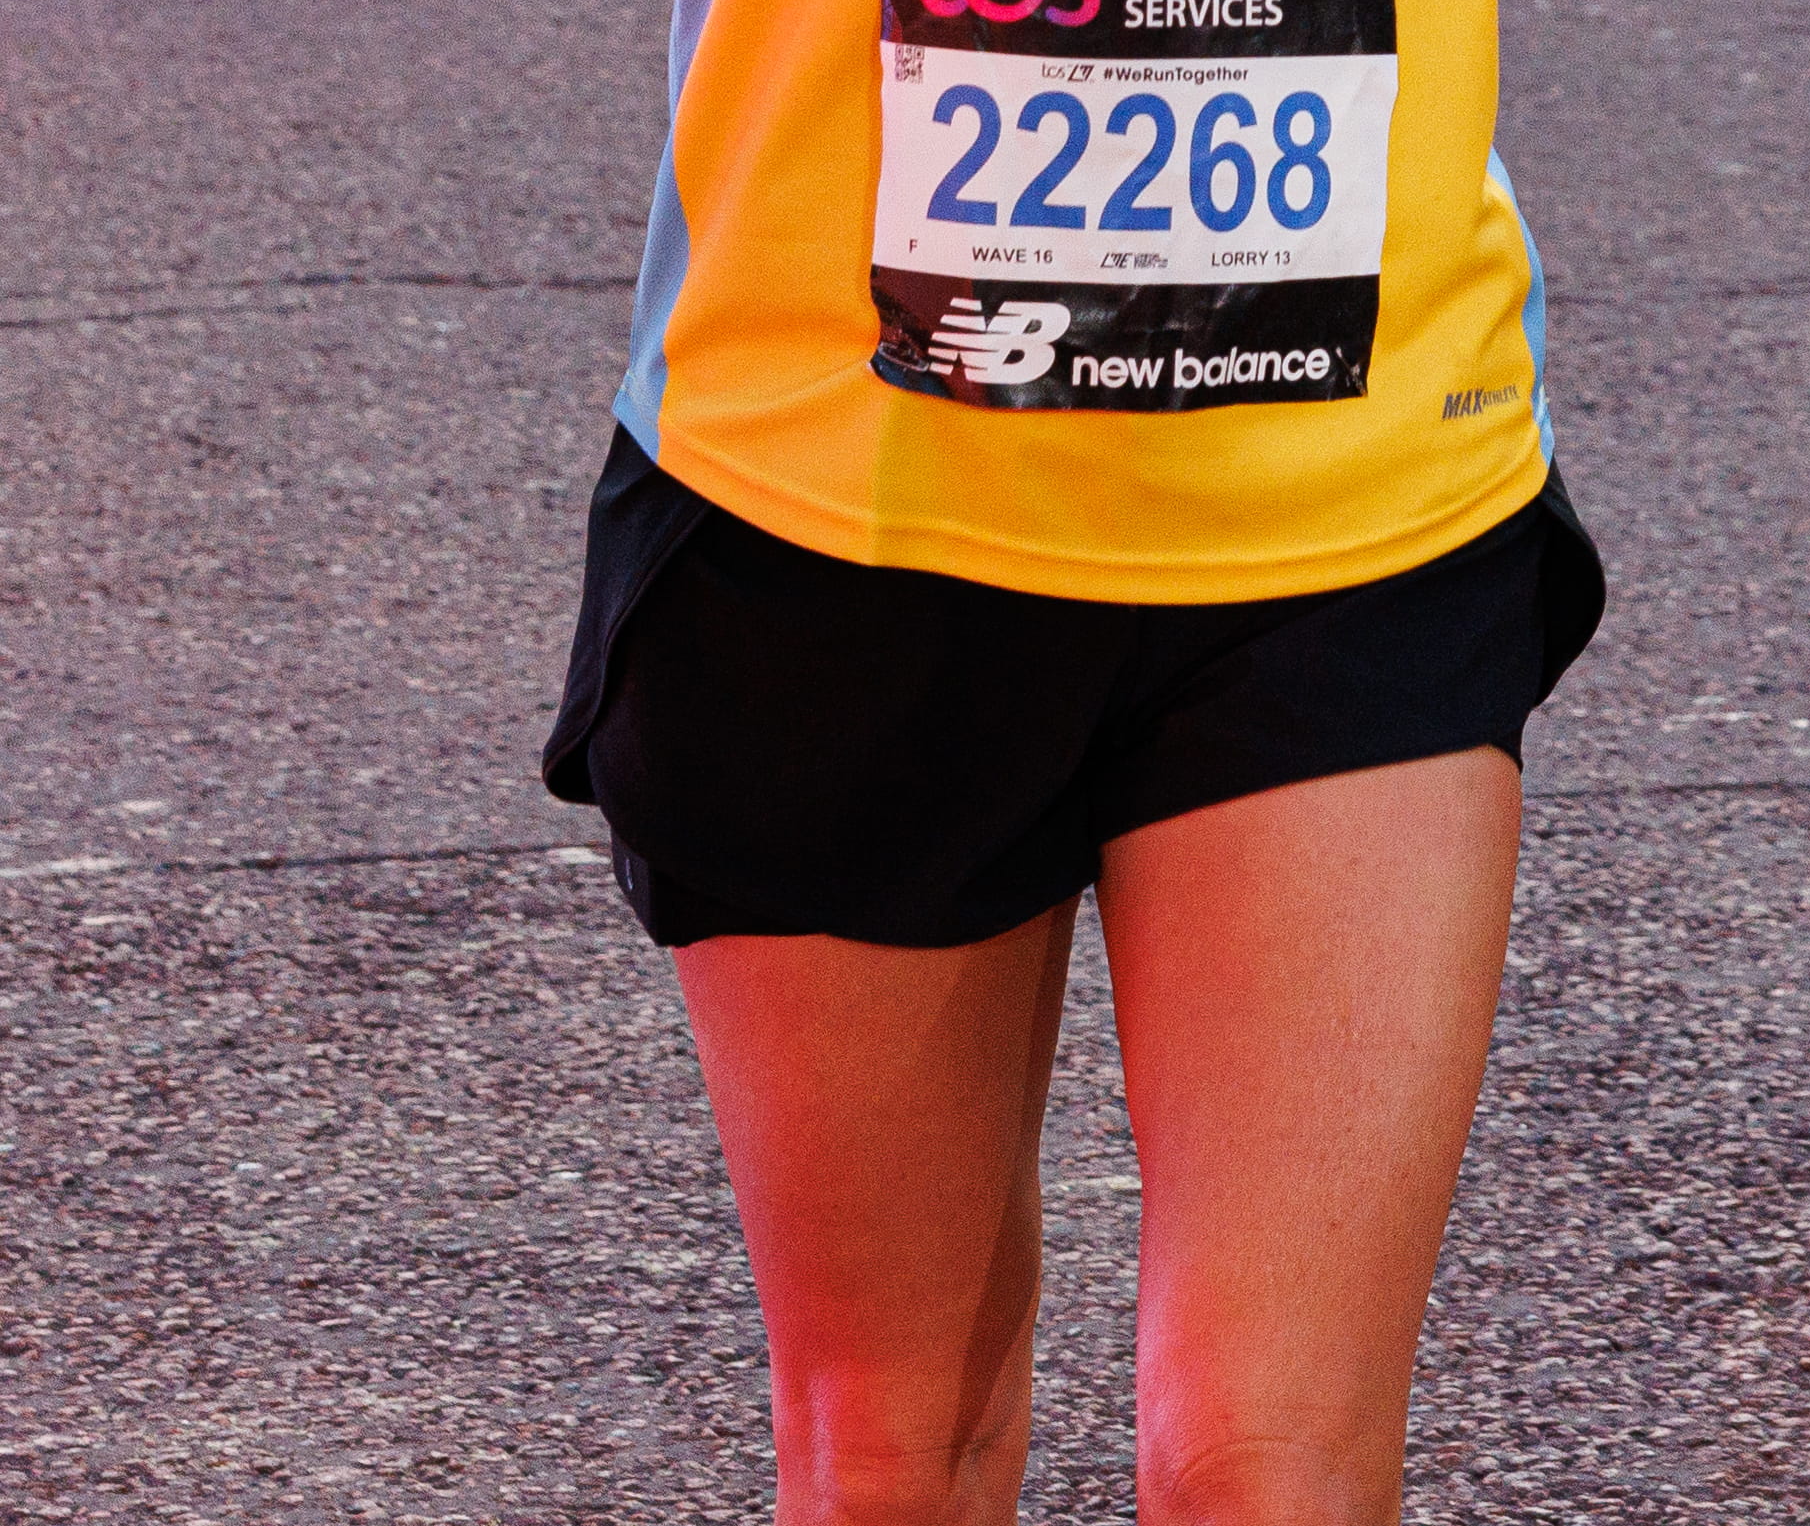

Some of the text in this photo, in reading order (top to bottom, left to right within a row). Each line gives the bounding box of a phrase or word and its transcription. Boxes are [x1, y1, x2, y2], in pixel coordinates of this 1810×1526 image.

[1103, 64, 1249, 86] #WeRunTogether
[927, 84, 1331, 231] 22268
[908, 239, 918, 254] F
[971, 246, 1053, 265] WAVE 16
[1210, 250, 1292, 267] LORRY 13
[1072, 358, 1164, 389] new
[1174, 346, 1331, 383] balance
